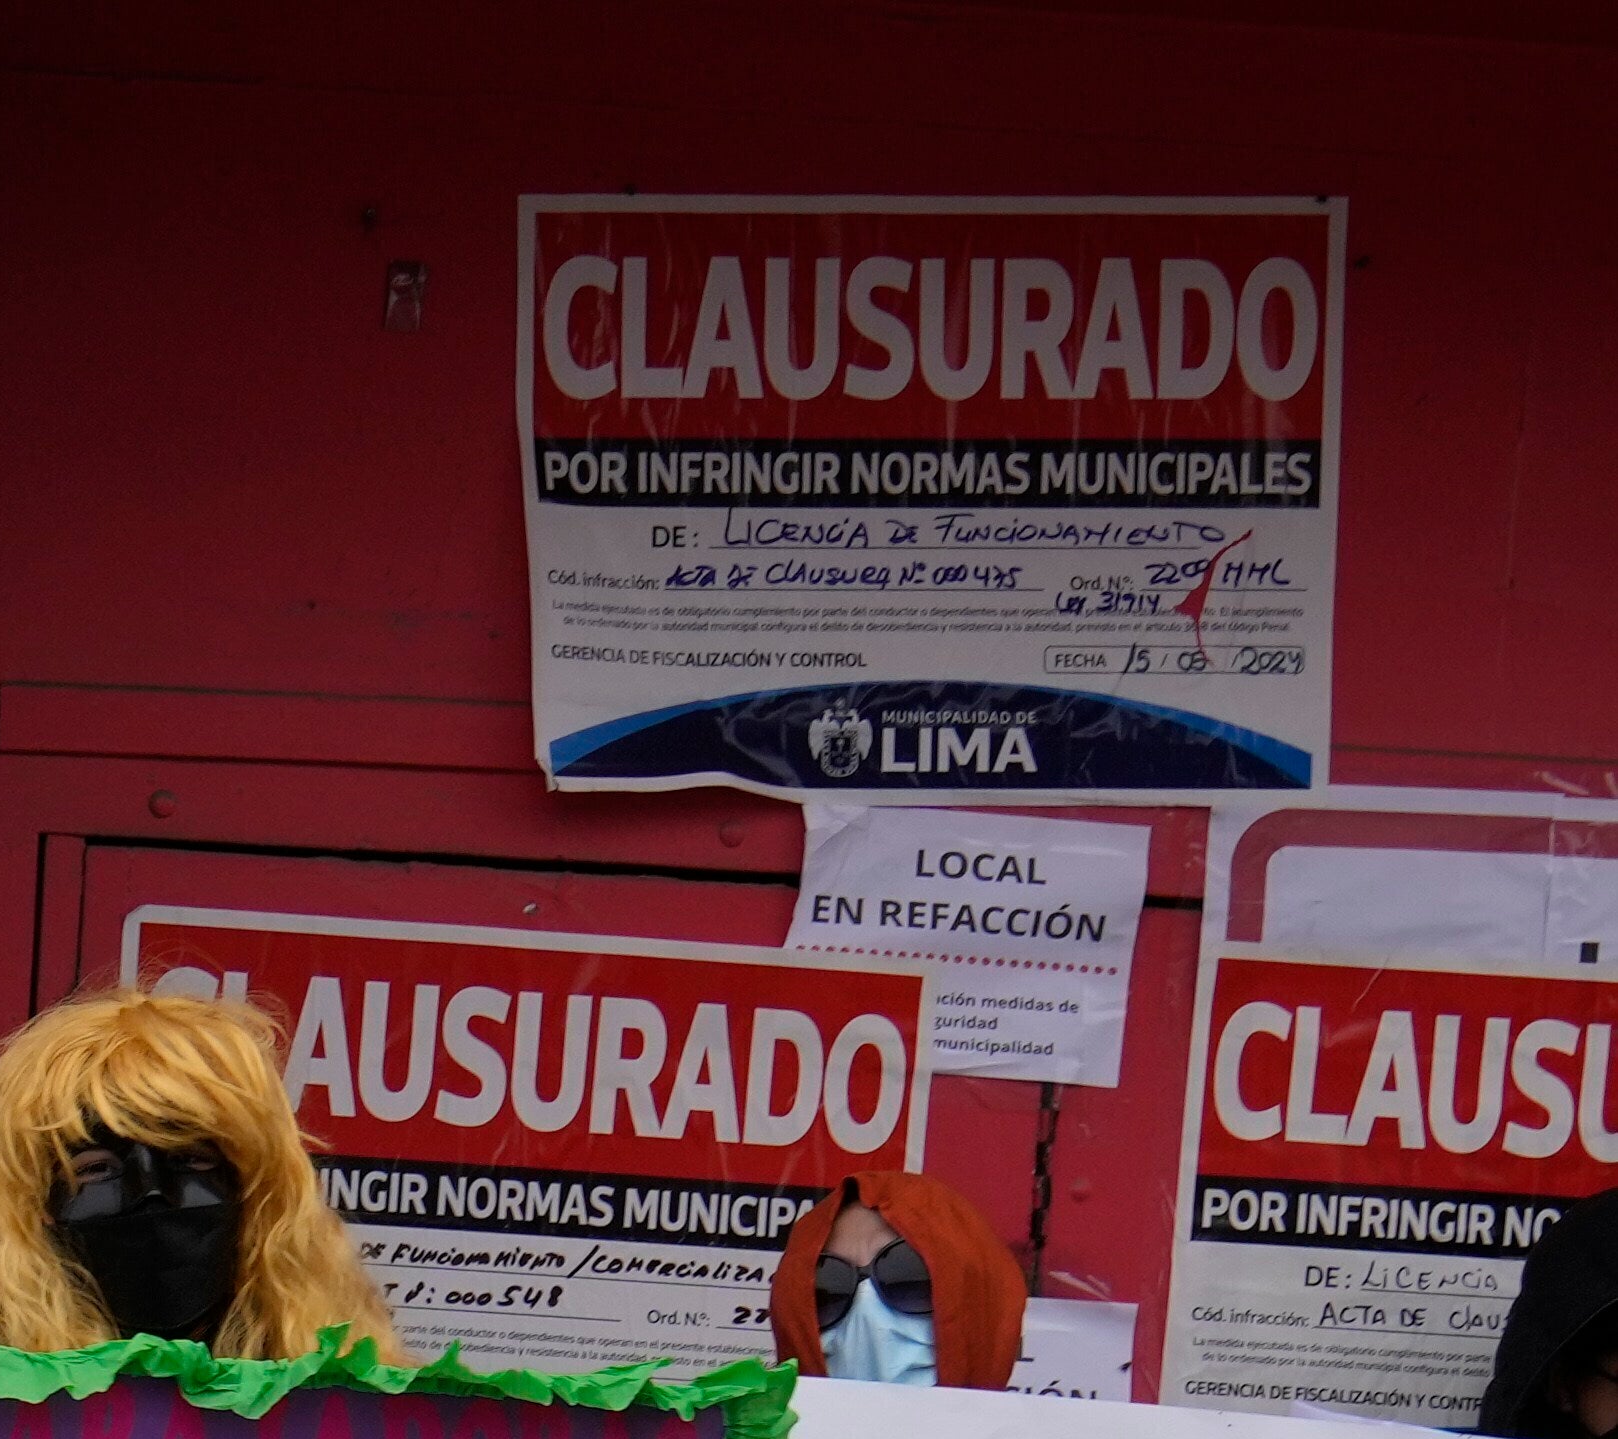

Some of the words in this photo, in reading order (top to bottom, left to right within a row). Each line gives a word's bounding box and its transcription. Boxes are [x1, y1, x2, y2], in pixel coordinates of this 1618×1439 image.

[544, 256, 1319, 401] CLAUSURADO
[545, 453, 628, 495] POR
[638, 453, 840, 495] INFRINGIR
[850, 453, 1030, 496] NORMAS
[1041, 453, 1311, 496] MUNICIPALES
[549, 570, 579, 586] Cód.
[582, 572, 660, 591] infracción:
[551, 644, 625, 665] GERENCIA
[629, 649, 649, 665] DE
[653, 648, 771, 667] FISCALIZACIÓN
[775, 652, 787, 666] Y
[790, 652, 867, 668] CONTROL
[1055, 653, 1106, 669] FECHA
[882, 708, 1007, 725] MUNICIPALIDAD
[1013, 708, 1037, 725] DE
[882, 730, 1038, 774] LIMA
[915, 849, 1046, 885] LOCAL
[811, 894, 863, 926] EN
[879, 900, 1106, 942] REFACCIÓN
[981, 995, 1054, 1013] medidas
[1058, 1000, 1079, 1014] de
[149, 965, 908, 1154] AUSURADO
[436, 1175, 616, 1228] NORMAS
[1201, 1188, 1286, 1233] POR
[1295, 1193, 1495, 1246] INFRINGIR
[647, 1310, 678, 1326] Ord.
[1191, 1306, 1226, 1322] Cód.
[1229, 1307, 1309, 1328] infracción:
[1185, 1379, 1265, 1399] GERENCIA
[1269, 1384, 1290, 1400] DE
[1295, 1386, 1412, 1408] FISCALIZACIÓN
[1414, 1393, 1426, 1409] Y
